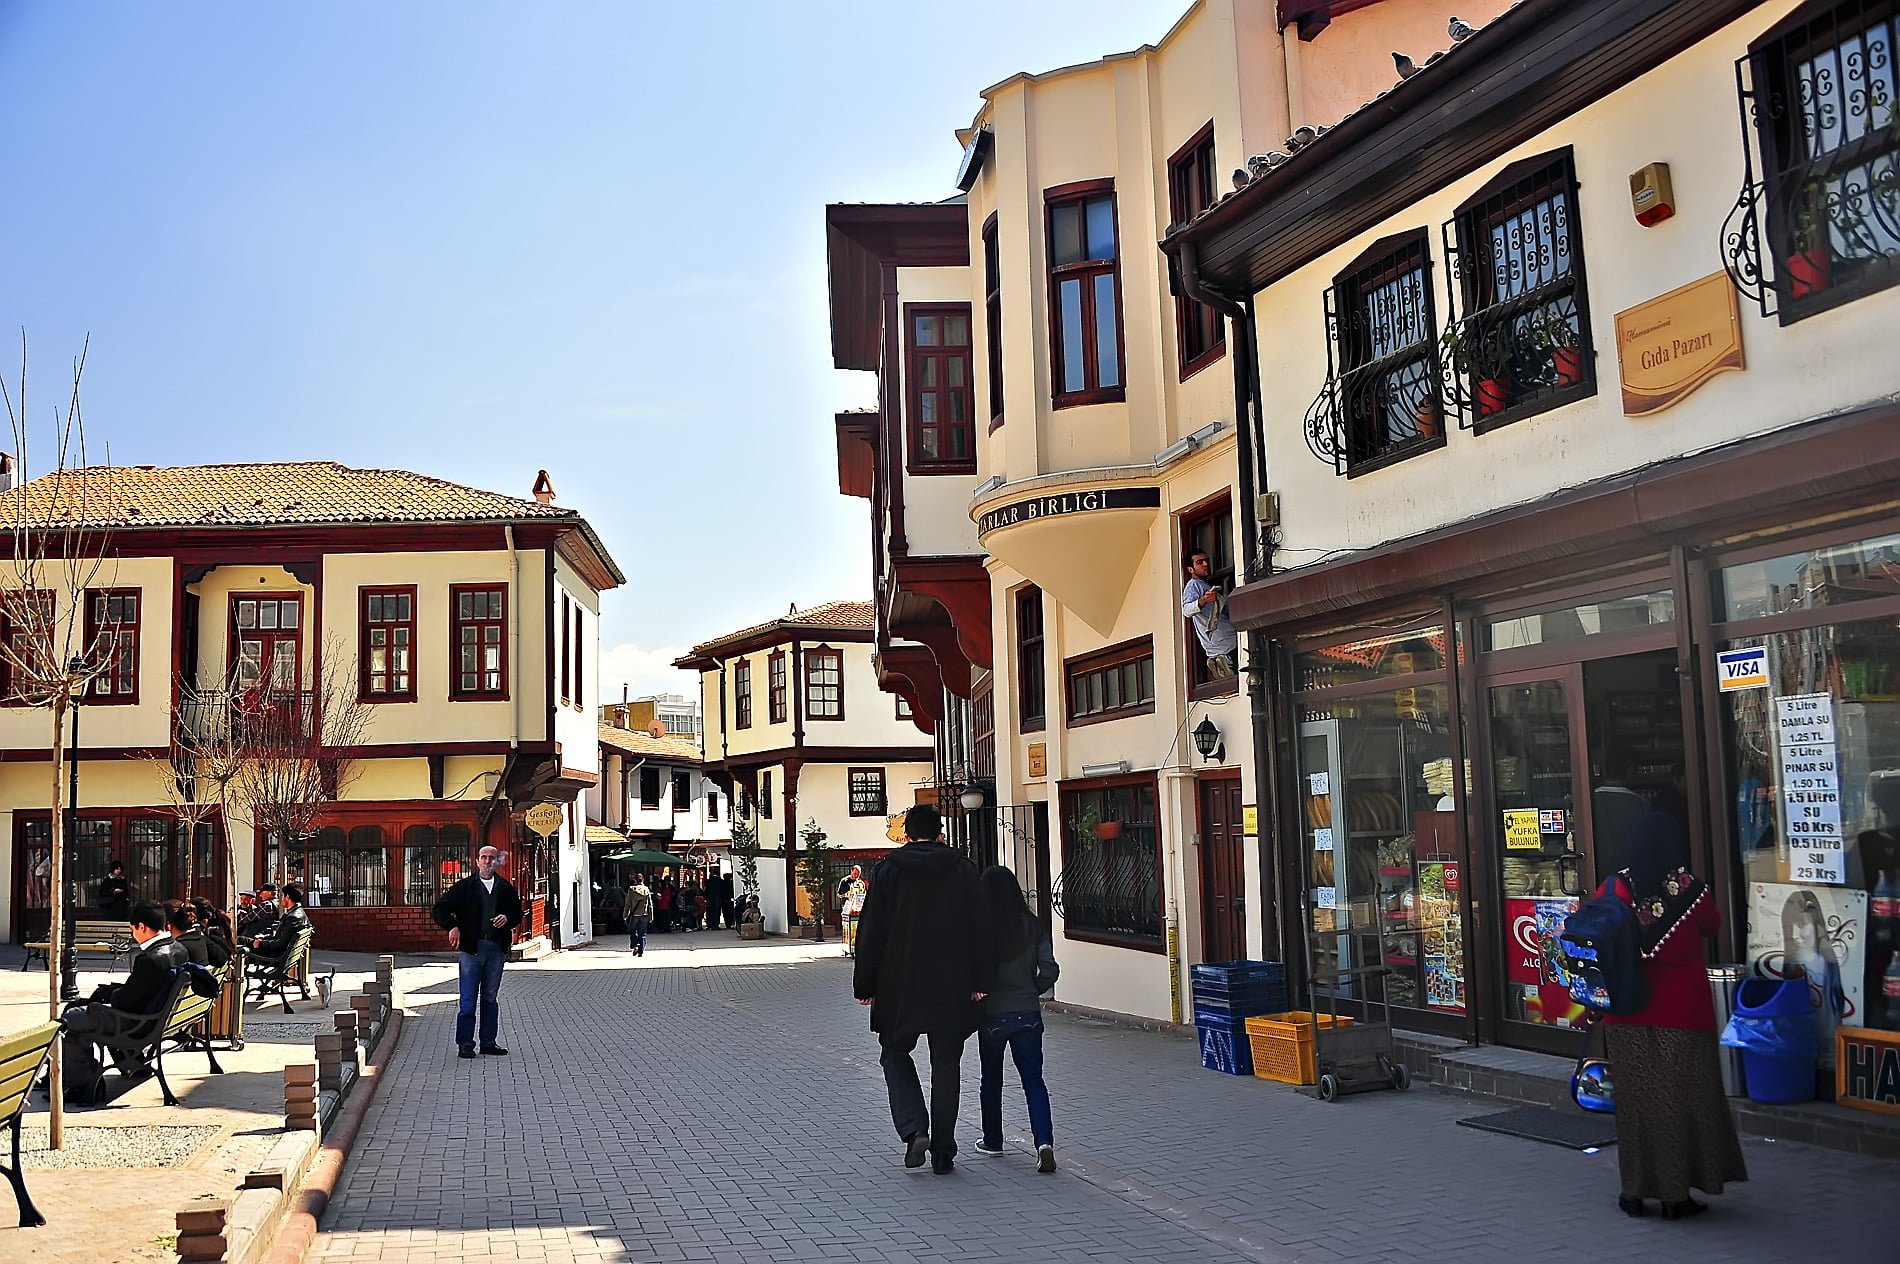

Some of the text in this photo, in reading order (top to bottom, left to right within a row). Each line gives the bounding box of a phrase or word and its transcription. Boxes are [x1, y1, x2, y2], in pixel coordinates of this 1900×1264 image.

[1641, 332, 1712, 370] Gıda Pazarı
[1028, 490, 1107, 518] BİRLİĞİ
[1726, 661, 1760, 678] VISA
[1787, 701, 1817, 711] 5 Litre
[1781, 715, 1830, 727] DAMLA SU
[1789, 732, 1824, 742] 1.25 TL
[1790, 747, 1823, 757] 5 Litre
[1785, 762, 1833, 773] PINAR SU
[1791, 778, 1829, 788] 1.50 TL
[1787, 792, 1837, 803] 1.5 Litre
[1803, 806, 1821, 818] SU
[1512, 827, 1538, 836] YUFKA
[1792, 821, 1834, 834] 50 Krş
[1509, 837, 1539, 846] BULUNUR
[1791, 838, 1841, 850] 0.5 Litre
[1808, 853, 1825, 864] SU
[1797, 867, 1837, 881] 25 Krş
